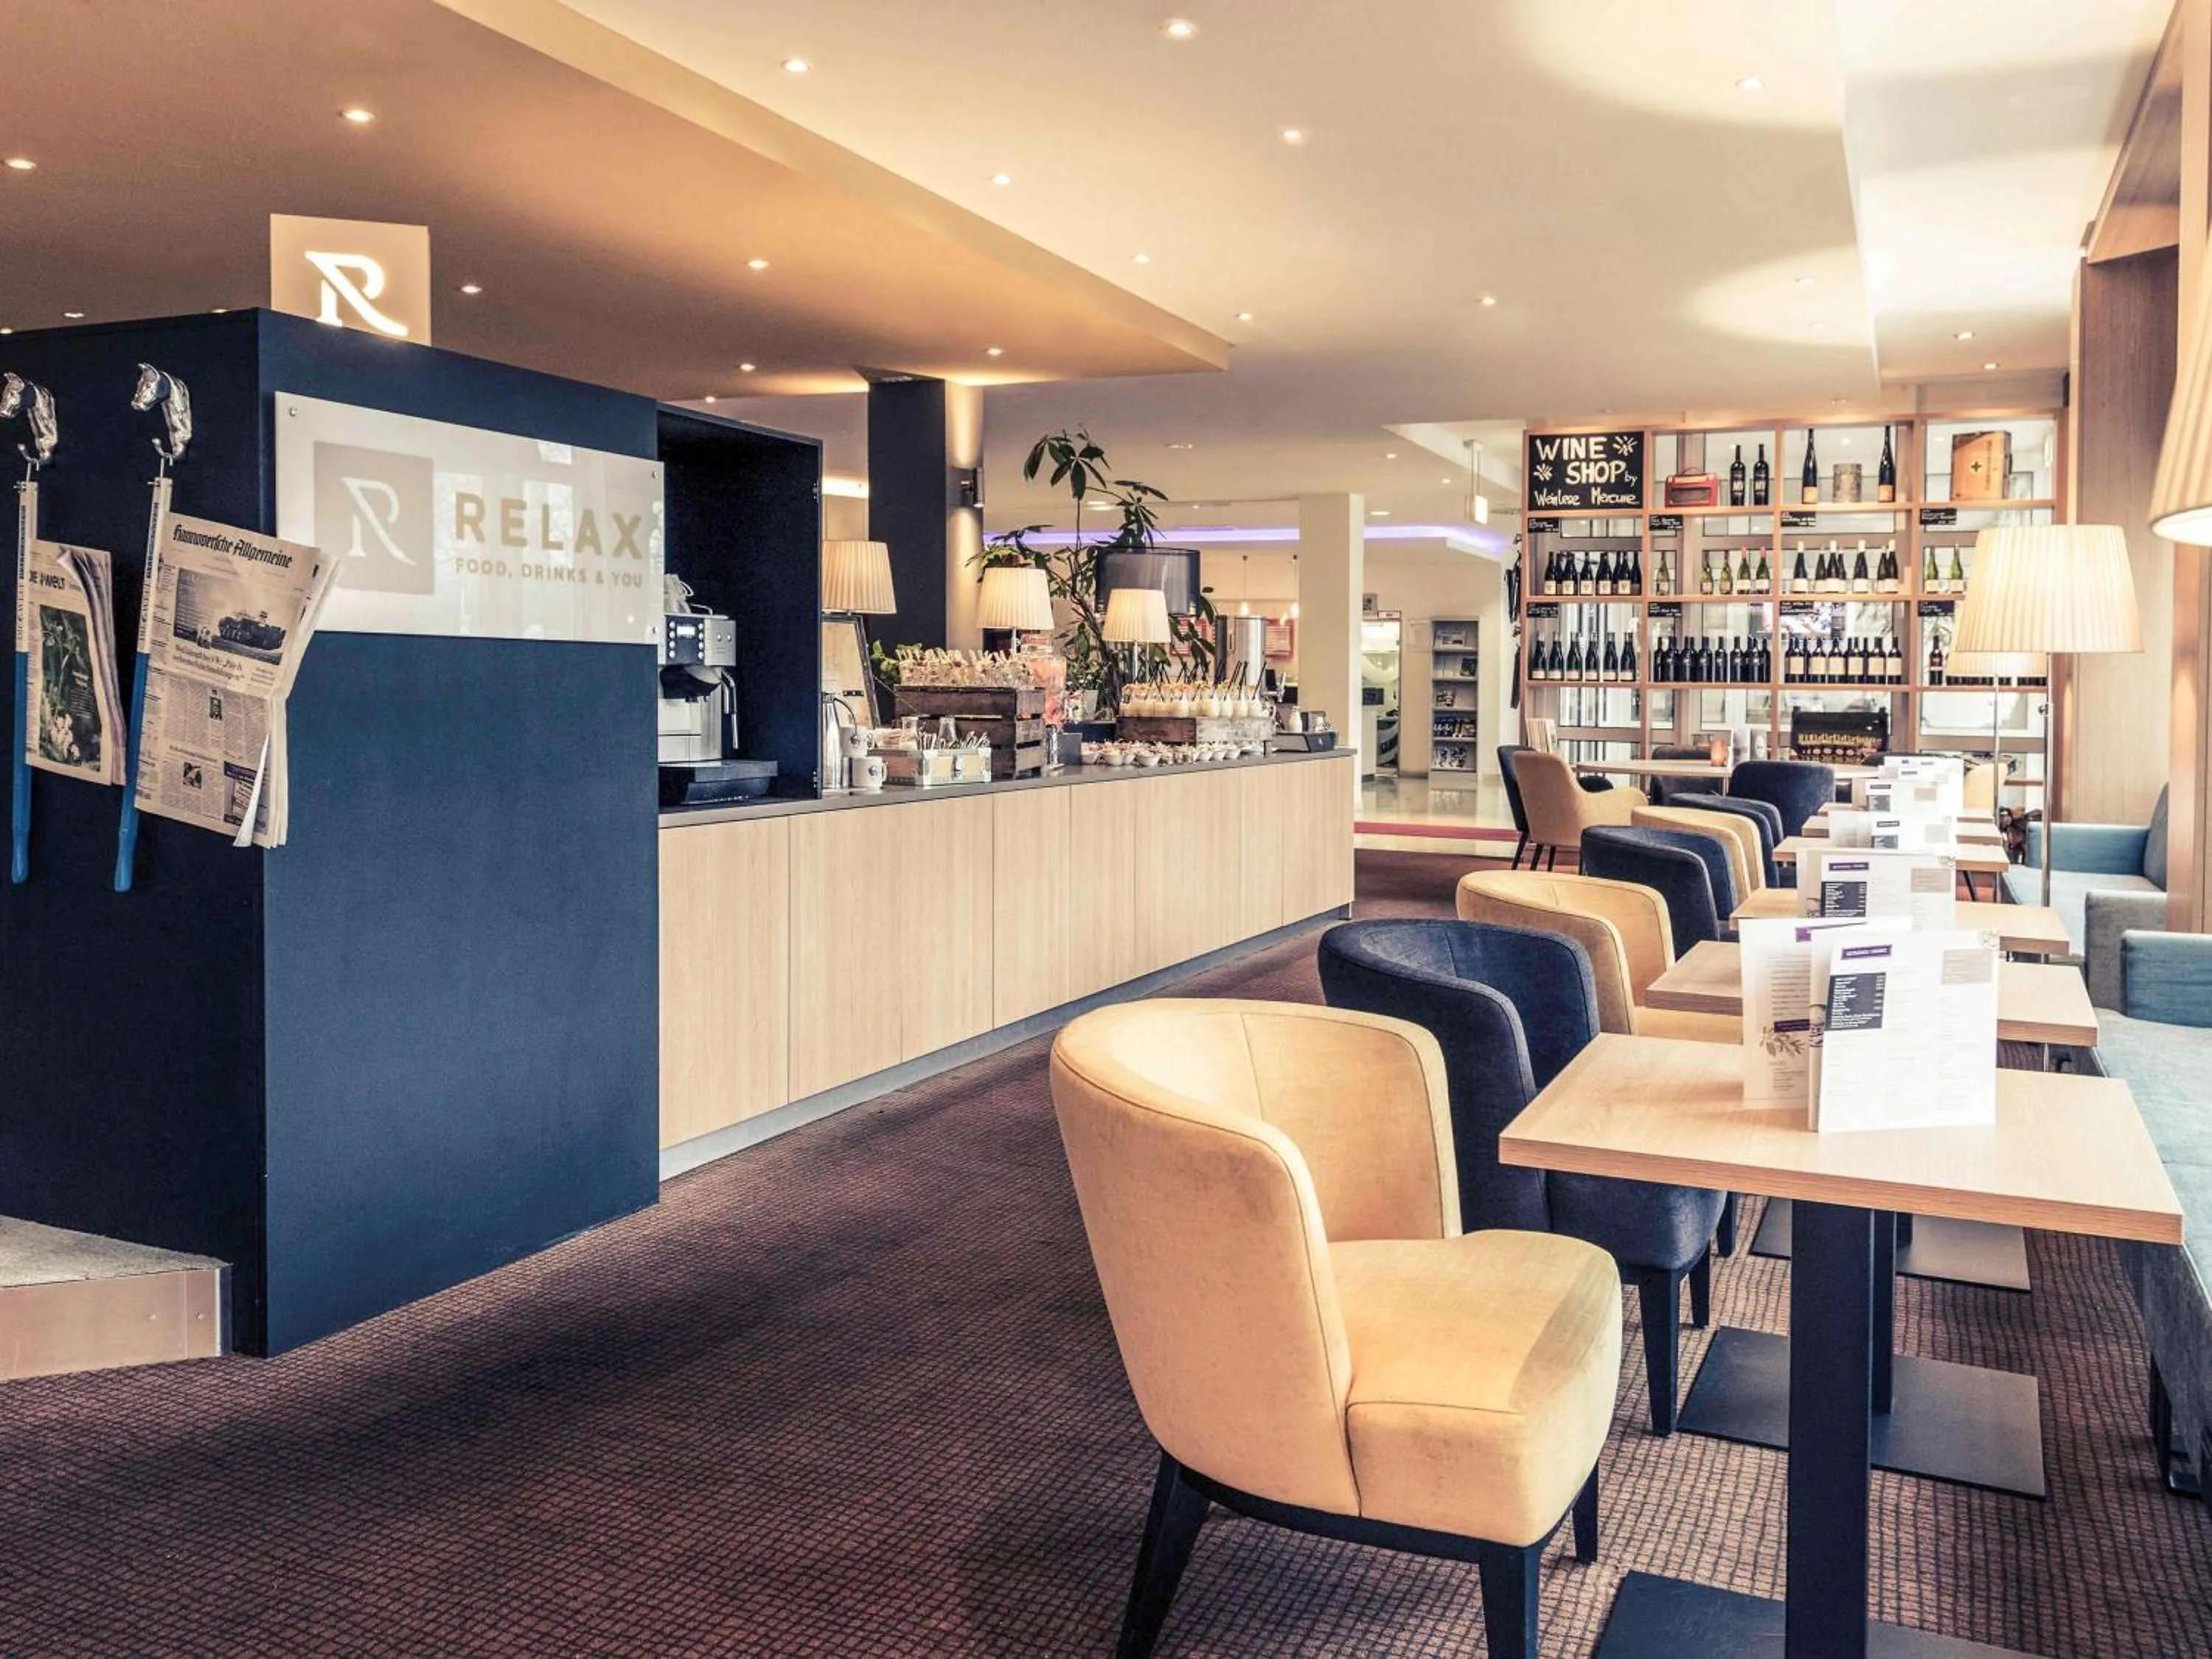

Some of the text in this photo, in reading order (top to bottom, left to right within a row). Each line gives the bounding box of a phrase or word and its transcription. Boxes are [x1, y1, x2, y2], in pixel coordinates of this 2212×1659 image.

[305, 251, 408, 338] R
[1535, 437, 1607, 461] WINE
[1565, 460, 1638, 487] SHOP by
[1591, 486, 1640, 505] Mercure
[341, 476, 417, 566] R
[455, 492, 642, 560] RELAX
[233, 539, 293, 568] Allgemeine
[456, 557, 643, 588] FOOD, DRINKS & YOU
